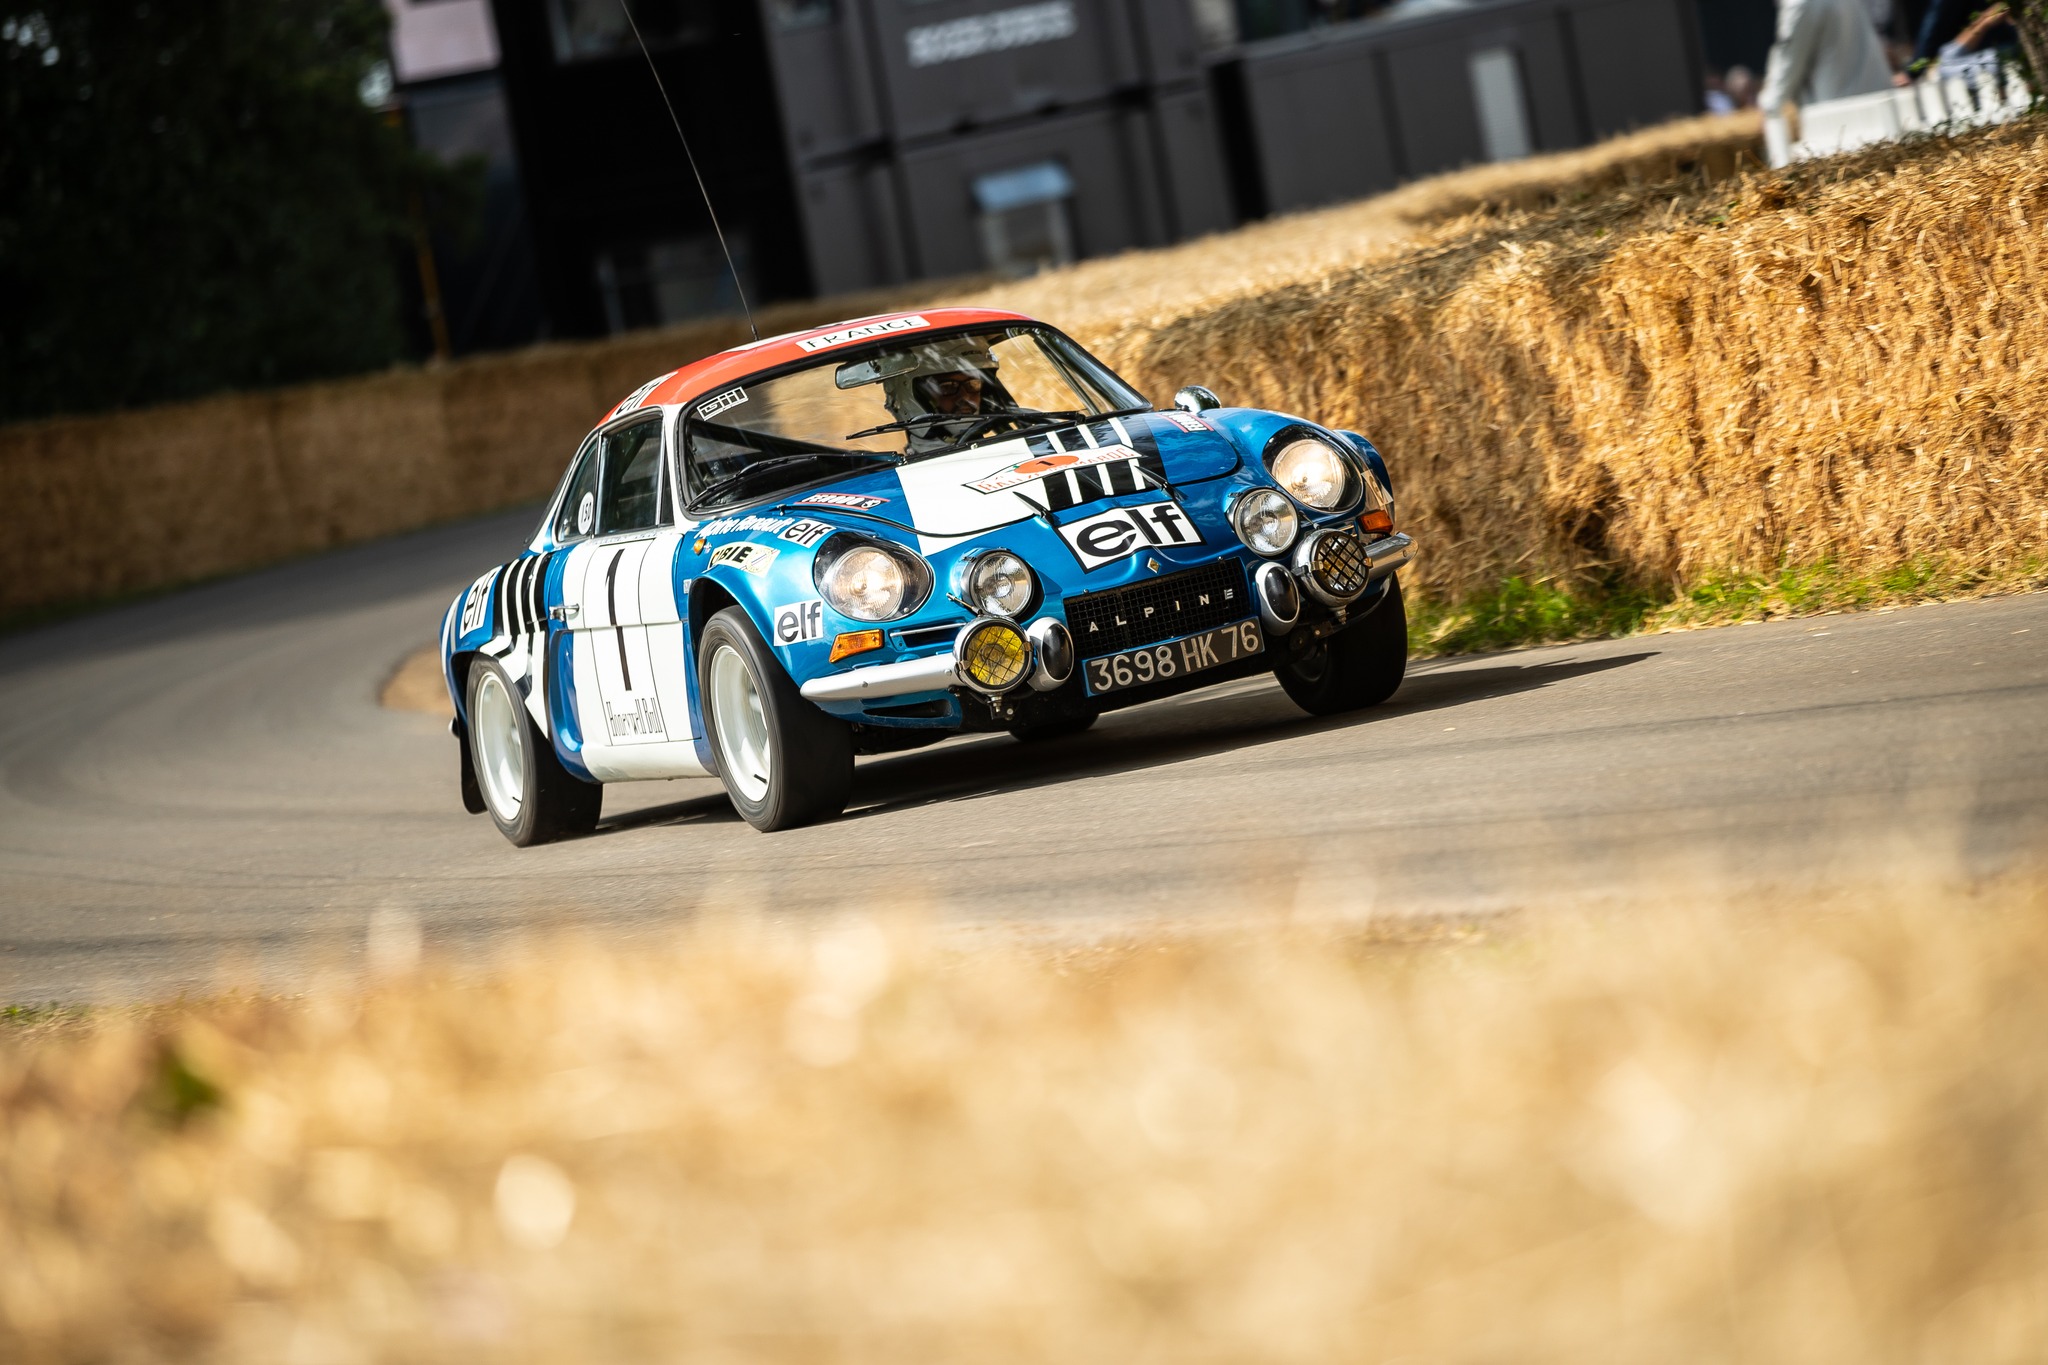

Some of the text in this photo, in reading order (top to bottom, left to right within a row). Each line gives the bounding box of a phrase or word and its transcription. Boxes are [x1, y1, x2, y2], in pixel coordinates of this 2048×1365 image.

[806, 318, 922, 349] FRANCE
[694, 517, 740, 539] Alpine
[731, 515, 795, 534] Renault
[784, 522, 832, 545] elf
[1076, 504, 1187, 557] elf
[463, 570, 498, 632] elf
[604, 548, 632, 691] 1
[777, 601, 821, 643] elf
[1089, 588, 1234, 633] ALPINE
[1090, 621, 1259, 691] 3698 HK 76
[641, 697, 663, 734] Bull
